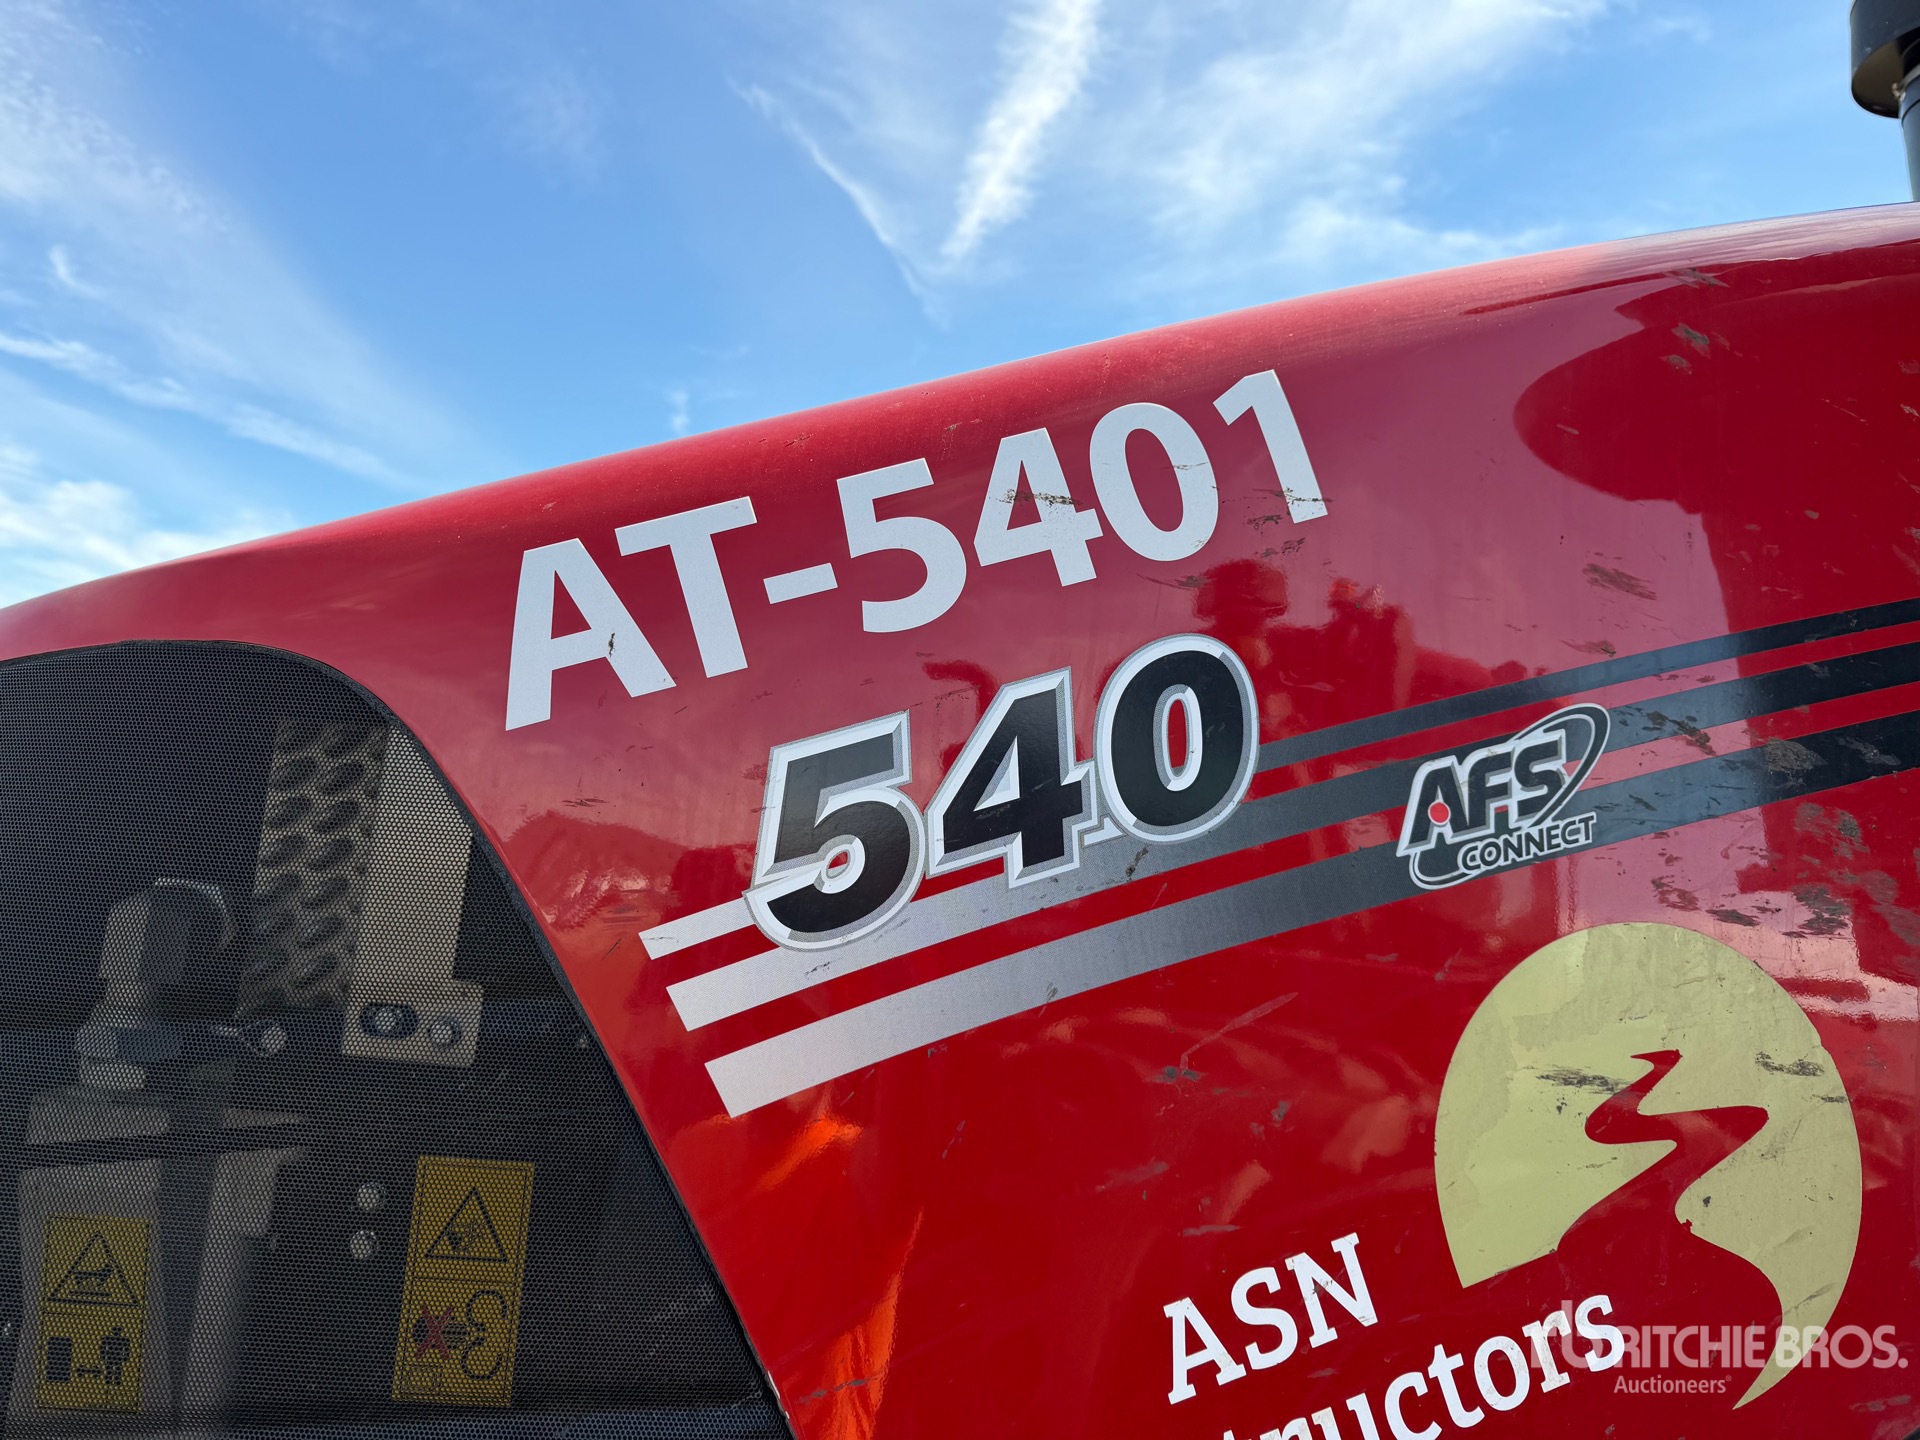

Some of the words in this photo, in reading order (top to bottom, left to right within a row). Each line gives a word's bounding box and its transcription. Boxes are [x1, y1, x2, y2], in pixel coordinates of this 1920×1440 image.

[506, 370, 1330, 731] AT-5401
[743, 634, 1260, 951] 540
[1397, 730, 1568, 857] AFS
[1458, 812, 1597, 874] CONNECT
[1163, 1232, 1378, 1405] ASN
